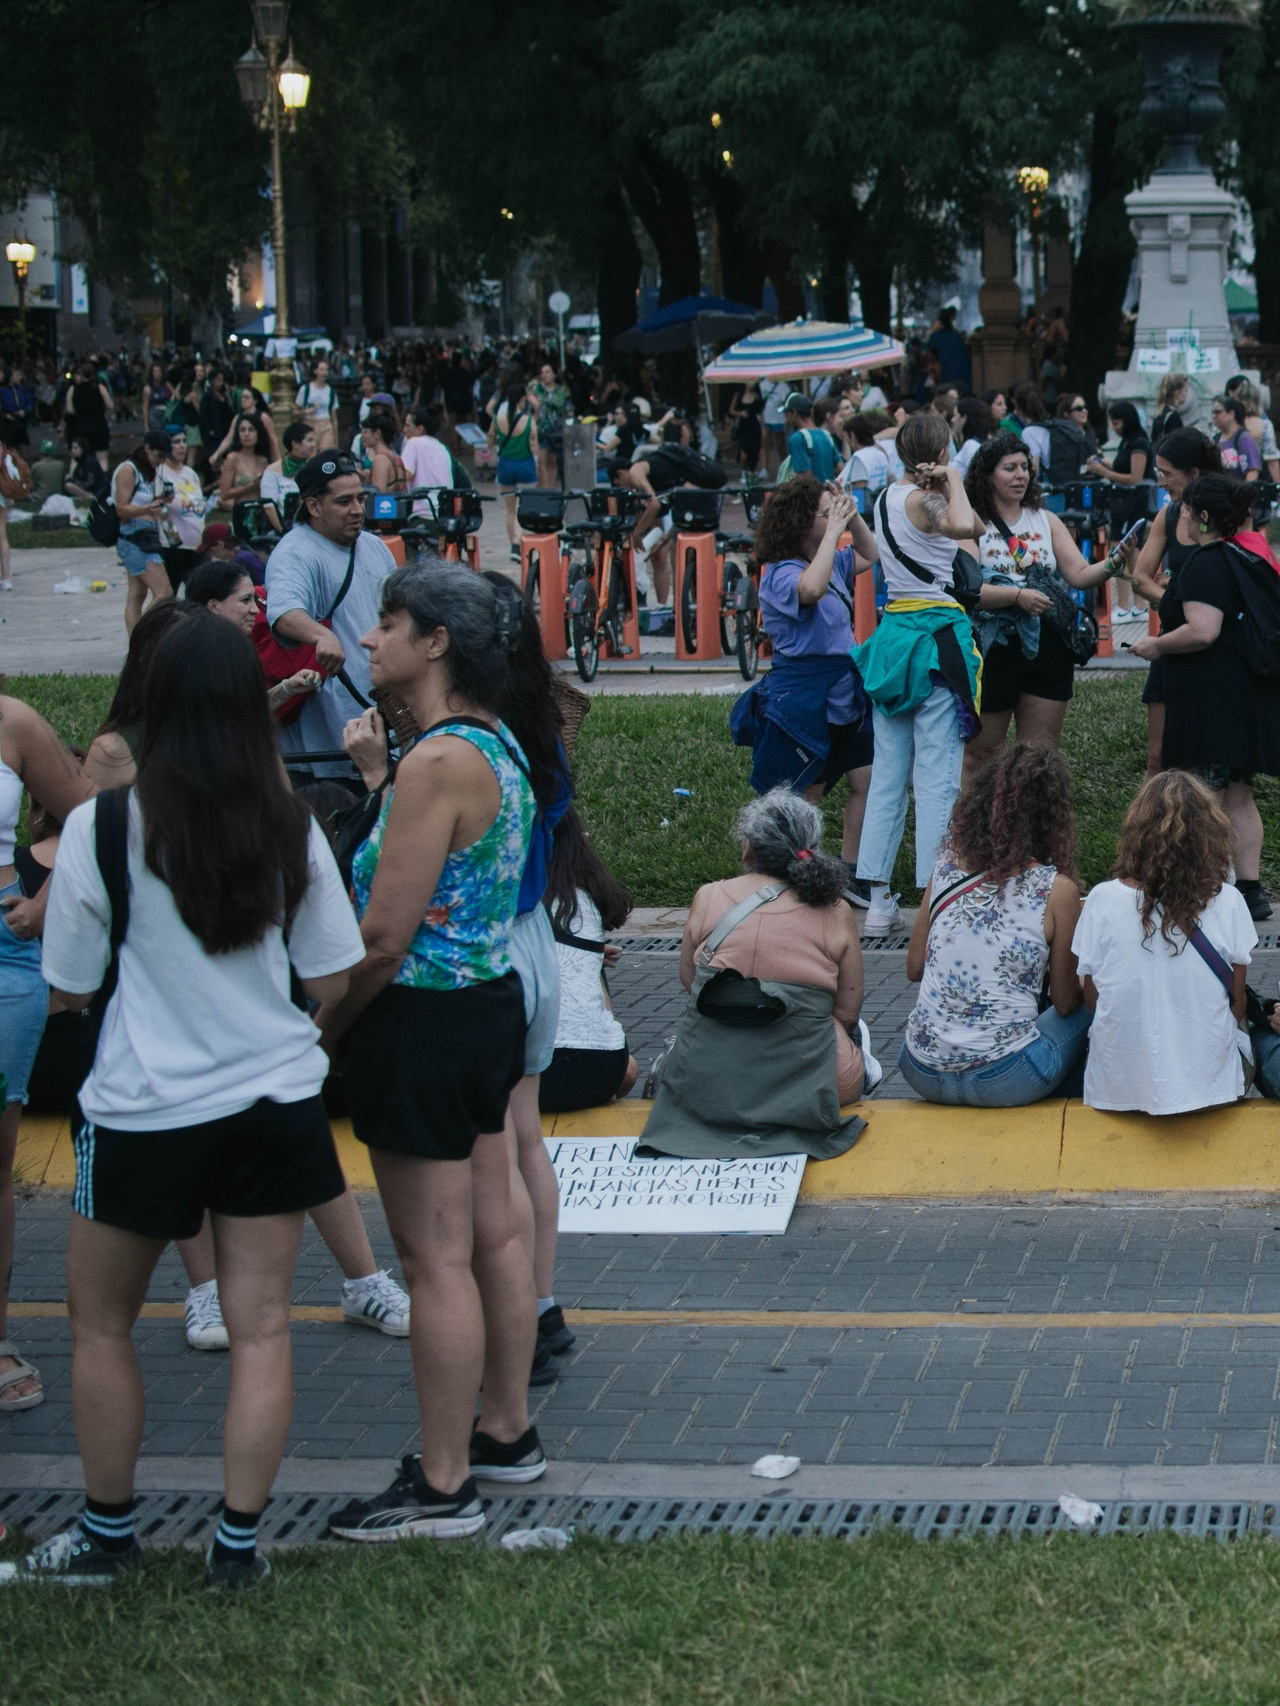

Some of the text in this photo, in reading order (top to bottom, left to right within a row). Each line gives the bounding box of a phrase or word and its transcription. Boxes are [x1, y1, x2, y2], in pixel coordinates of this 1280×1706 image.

[559, 1157, 799, 1179] LA DESHUMANIZACIÓN
[695, 1176, 785, 1191] LIBRES
[564, 1194, 607, 1210] HAY
[612, 1194, 706, 1208] FUTURO
